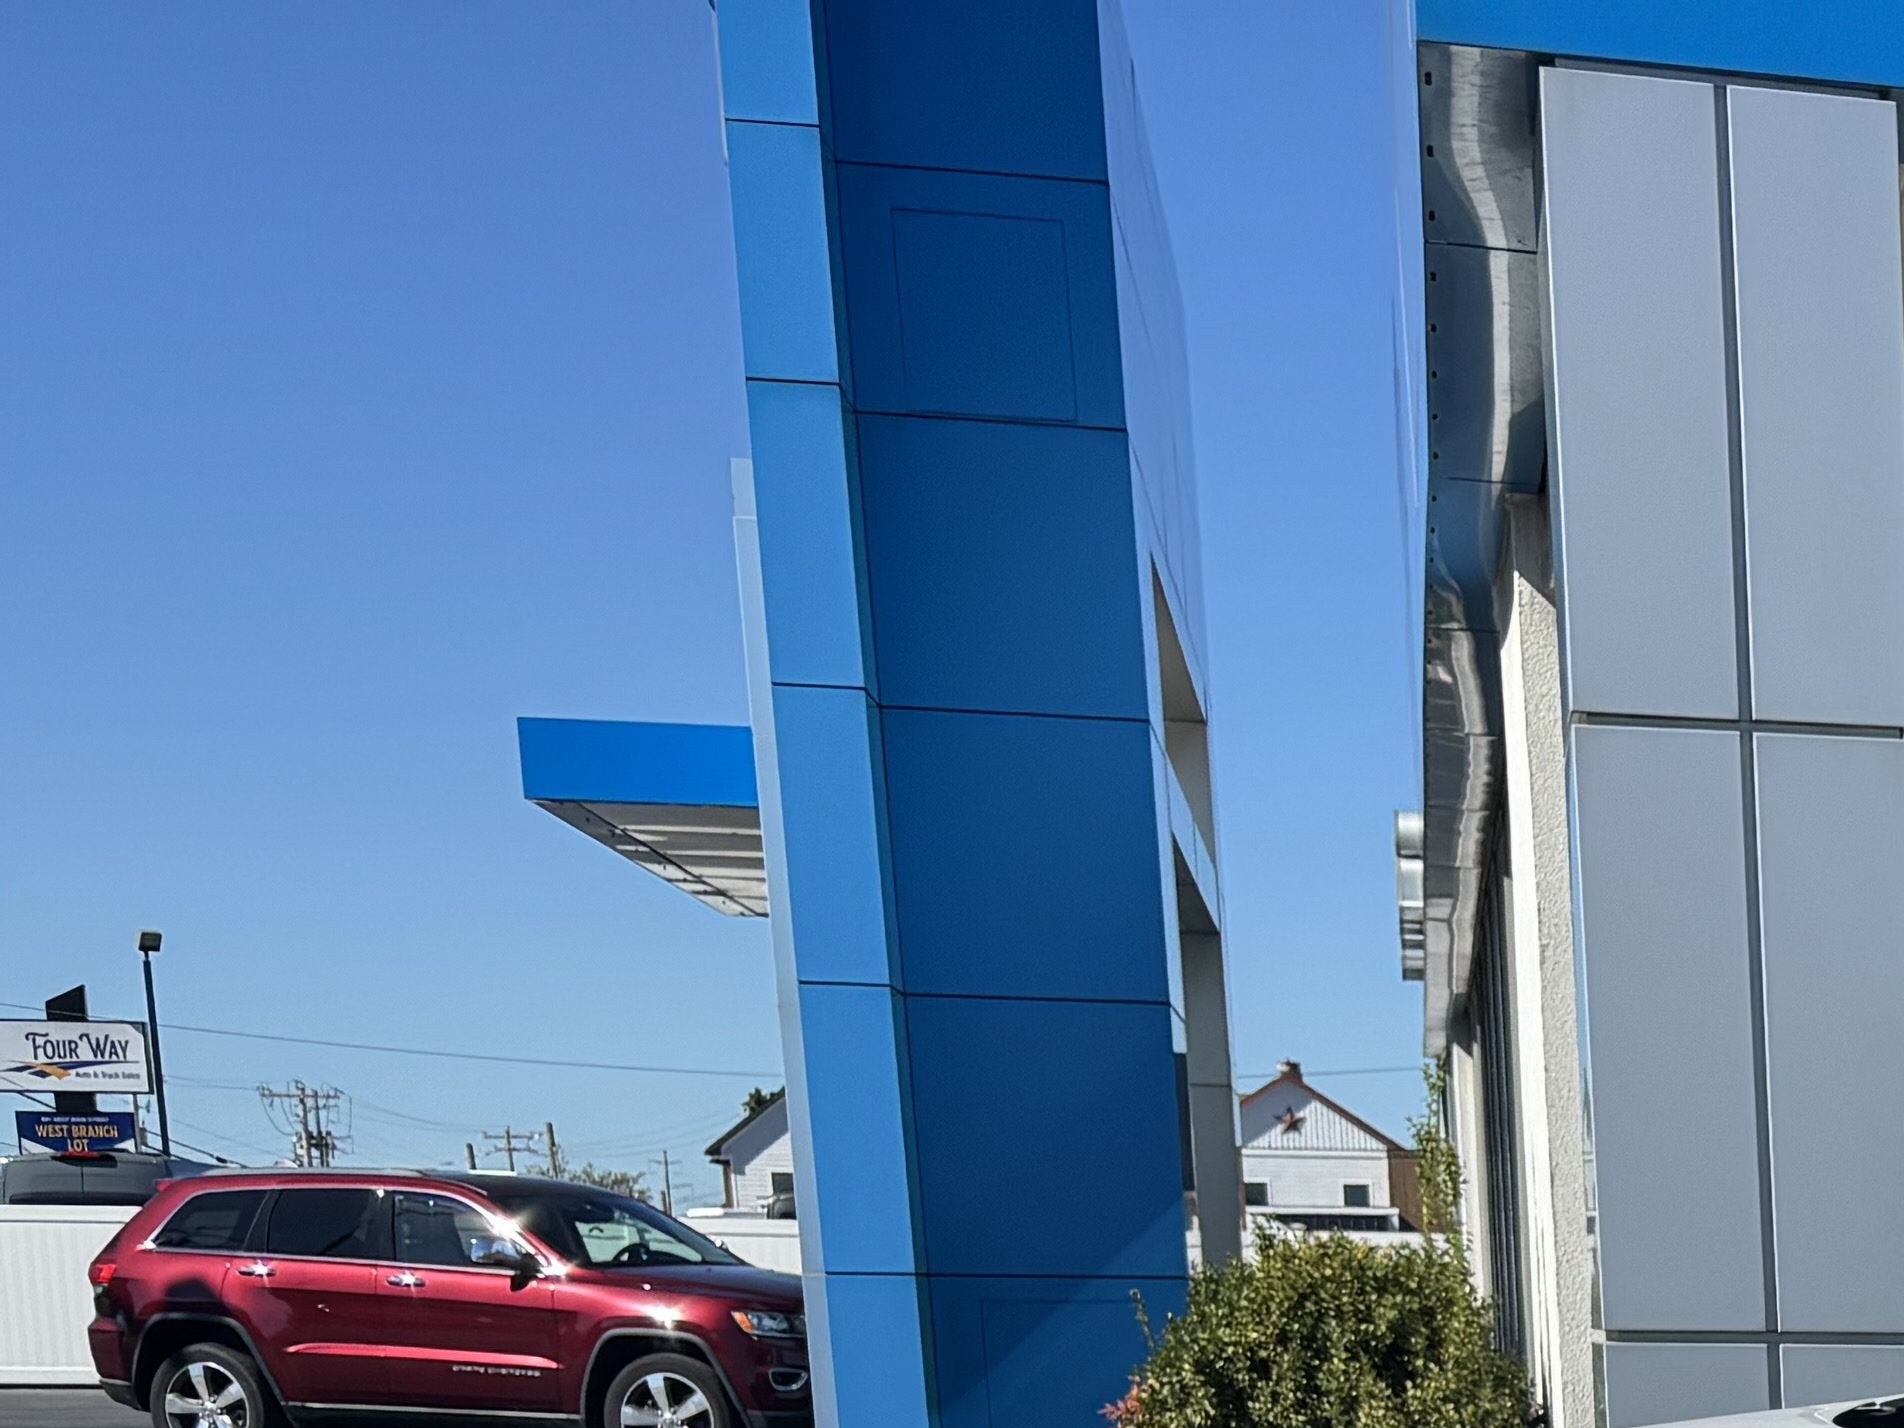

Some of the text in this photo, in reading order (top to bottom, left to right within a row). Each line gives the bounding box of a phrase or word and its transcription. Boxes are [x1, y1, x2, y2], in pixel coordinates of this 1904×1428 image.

[25, 1032, 129, 1060] FOUR WAY
[35, 1124, 118, 1138] WEST BRANCH
[67, 1138, 90, 1152] LOT
